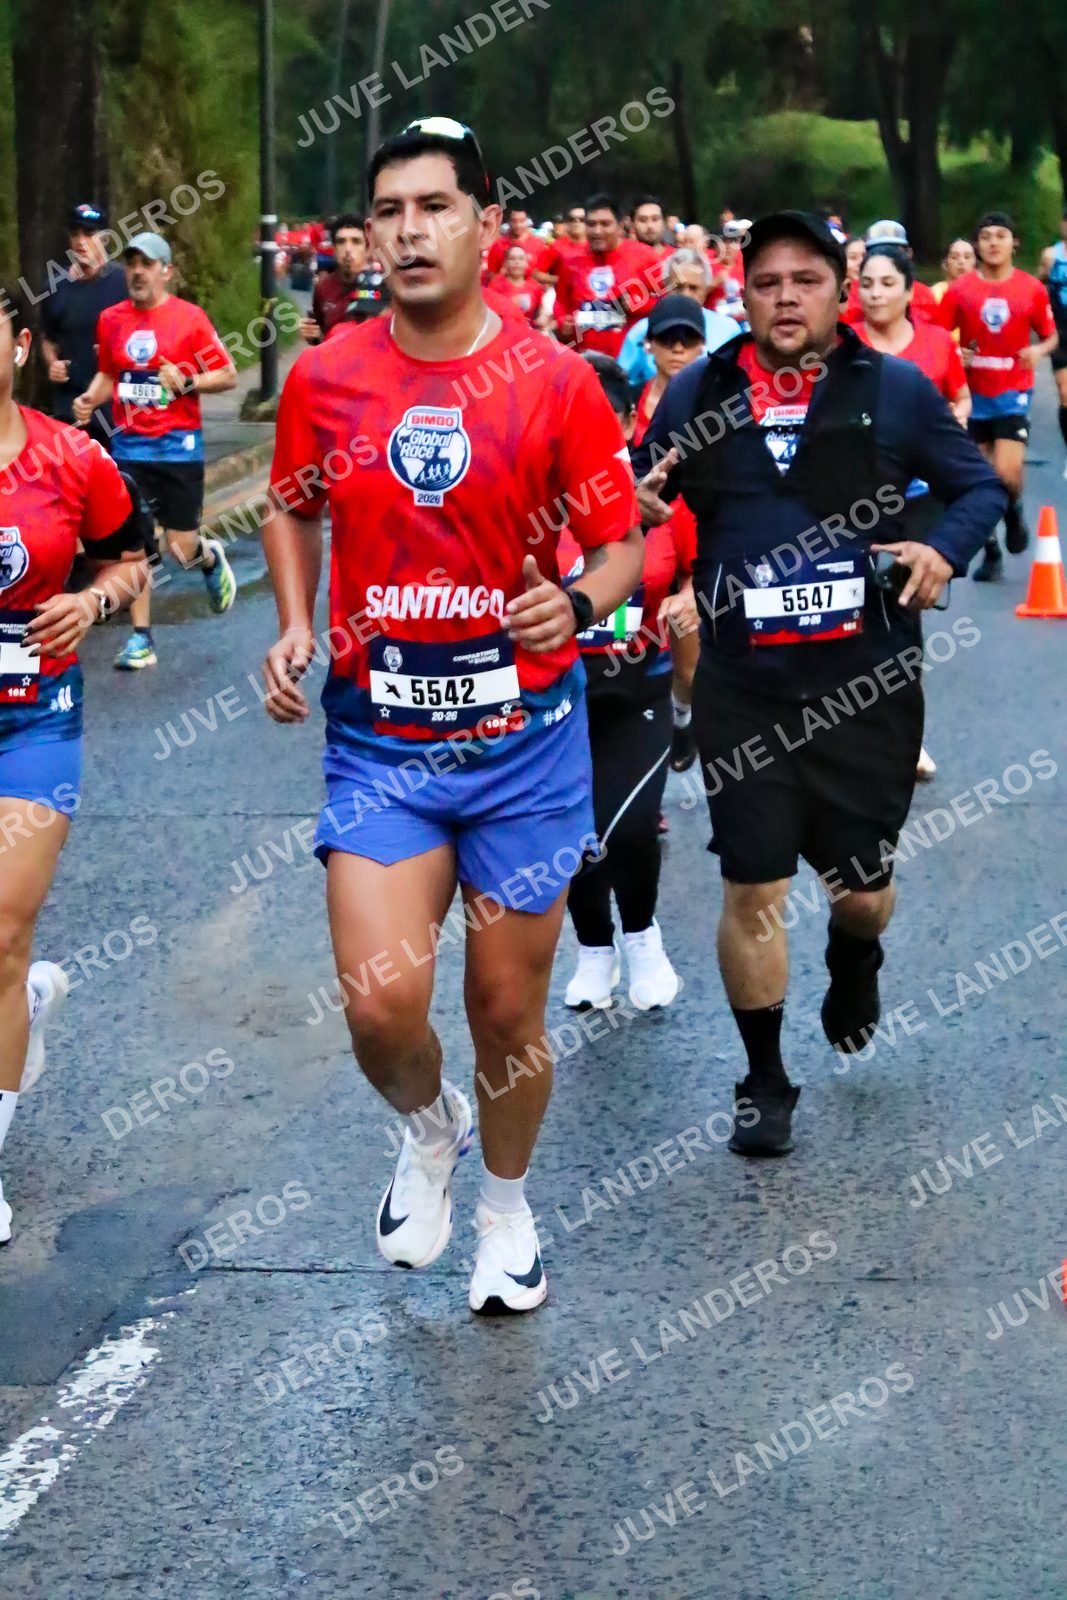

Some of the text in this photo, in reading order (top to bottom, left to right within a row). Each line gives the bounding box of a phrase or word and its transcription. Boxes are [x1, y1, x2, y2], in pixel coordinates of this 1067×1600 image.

[411, 415, 454, 427] BIMBO
[409, 430, 452, 447] Global
[400, 442, 435, 459] Race
[417, 493, 441, 504] 2026
[365, 584, 505, 619] SANTIAGO
[782, 584, 833, 612] 5547
[7, 688, 26, 697] 10K
[410, 677, 476, 706] 5542
[486, 717, 508, 729] 10K
